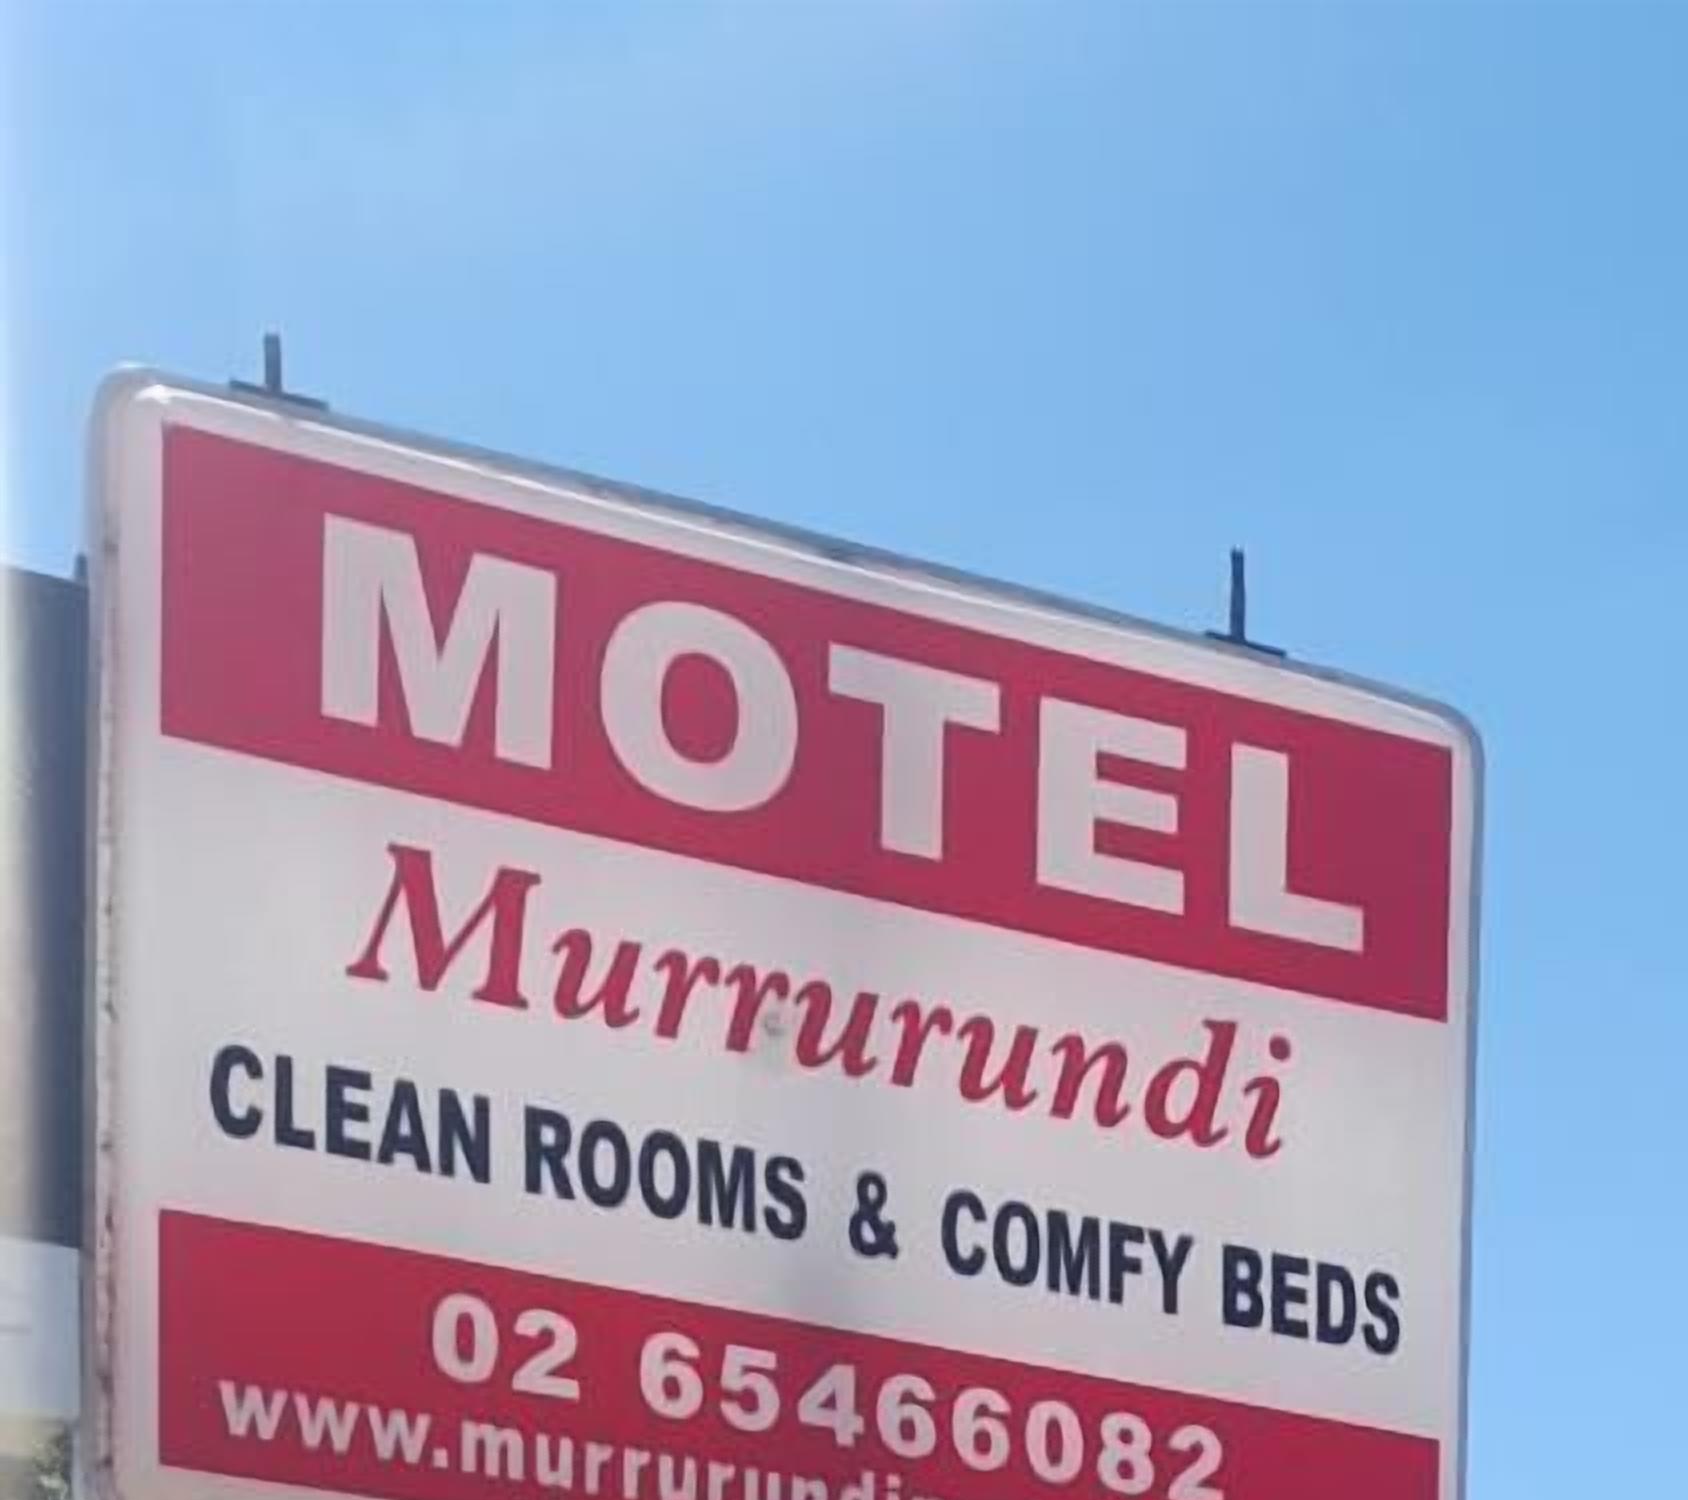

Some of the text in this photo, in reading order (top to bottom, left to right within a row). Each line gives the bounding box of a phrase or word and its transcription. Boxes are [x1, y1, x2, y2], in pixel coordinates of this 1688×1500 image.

[320, 512, 1365, 954] MOTEL
[348, 845, 1292, 1159] Murrurundi
[209, 1045, 1402, 1356] CLEAN ROOMS & COMFY BEDS
[432, 1293, 579, 1400] 02
